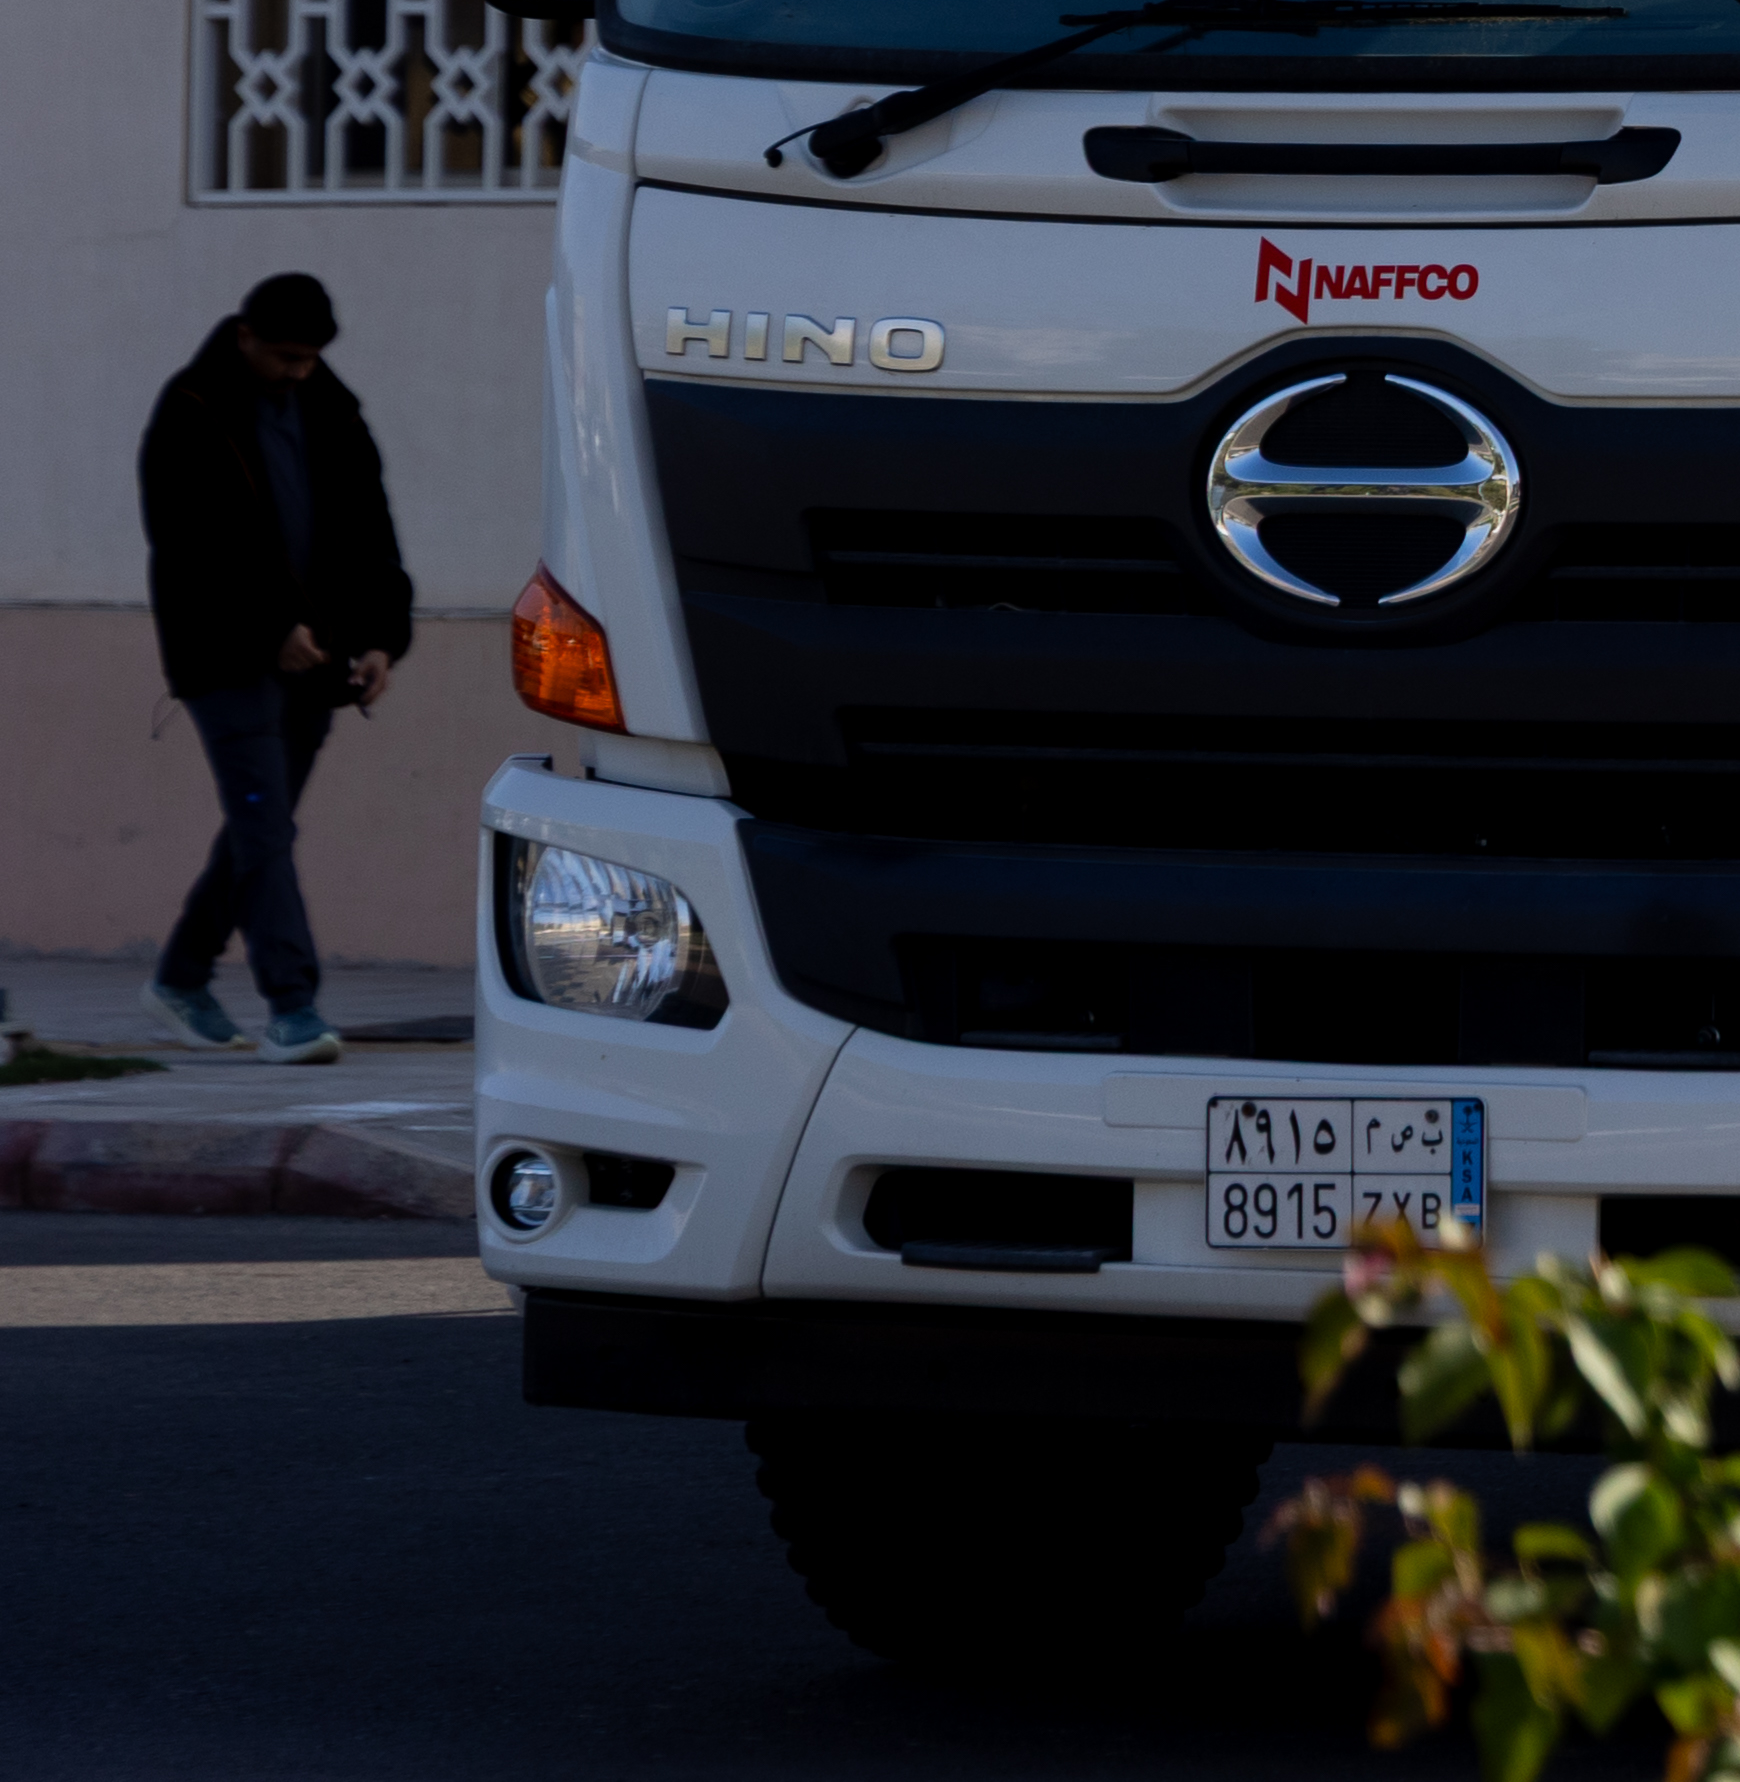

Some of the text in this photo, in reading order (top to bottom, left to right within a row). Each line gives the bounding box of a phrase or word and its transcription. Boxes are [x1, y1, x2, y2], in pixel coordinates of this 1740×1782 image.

[1313, 264, 1479, 301] NAFFCO
[664, 306, 945, 372] HINO
[1225, 1108, 1336, 1165] ٨٩١٥
[1223, 1183, 1337, 1239] 8915
